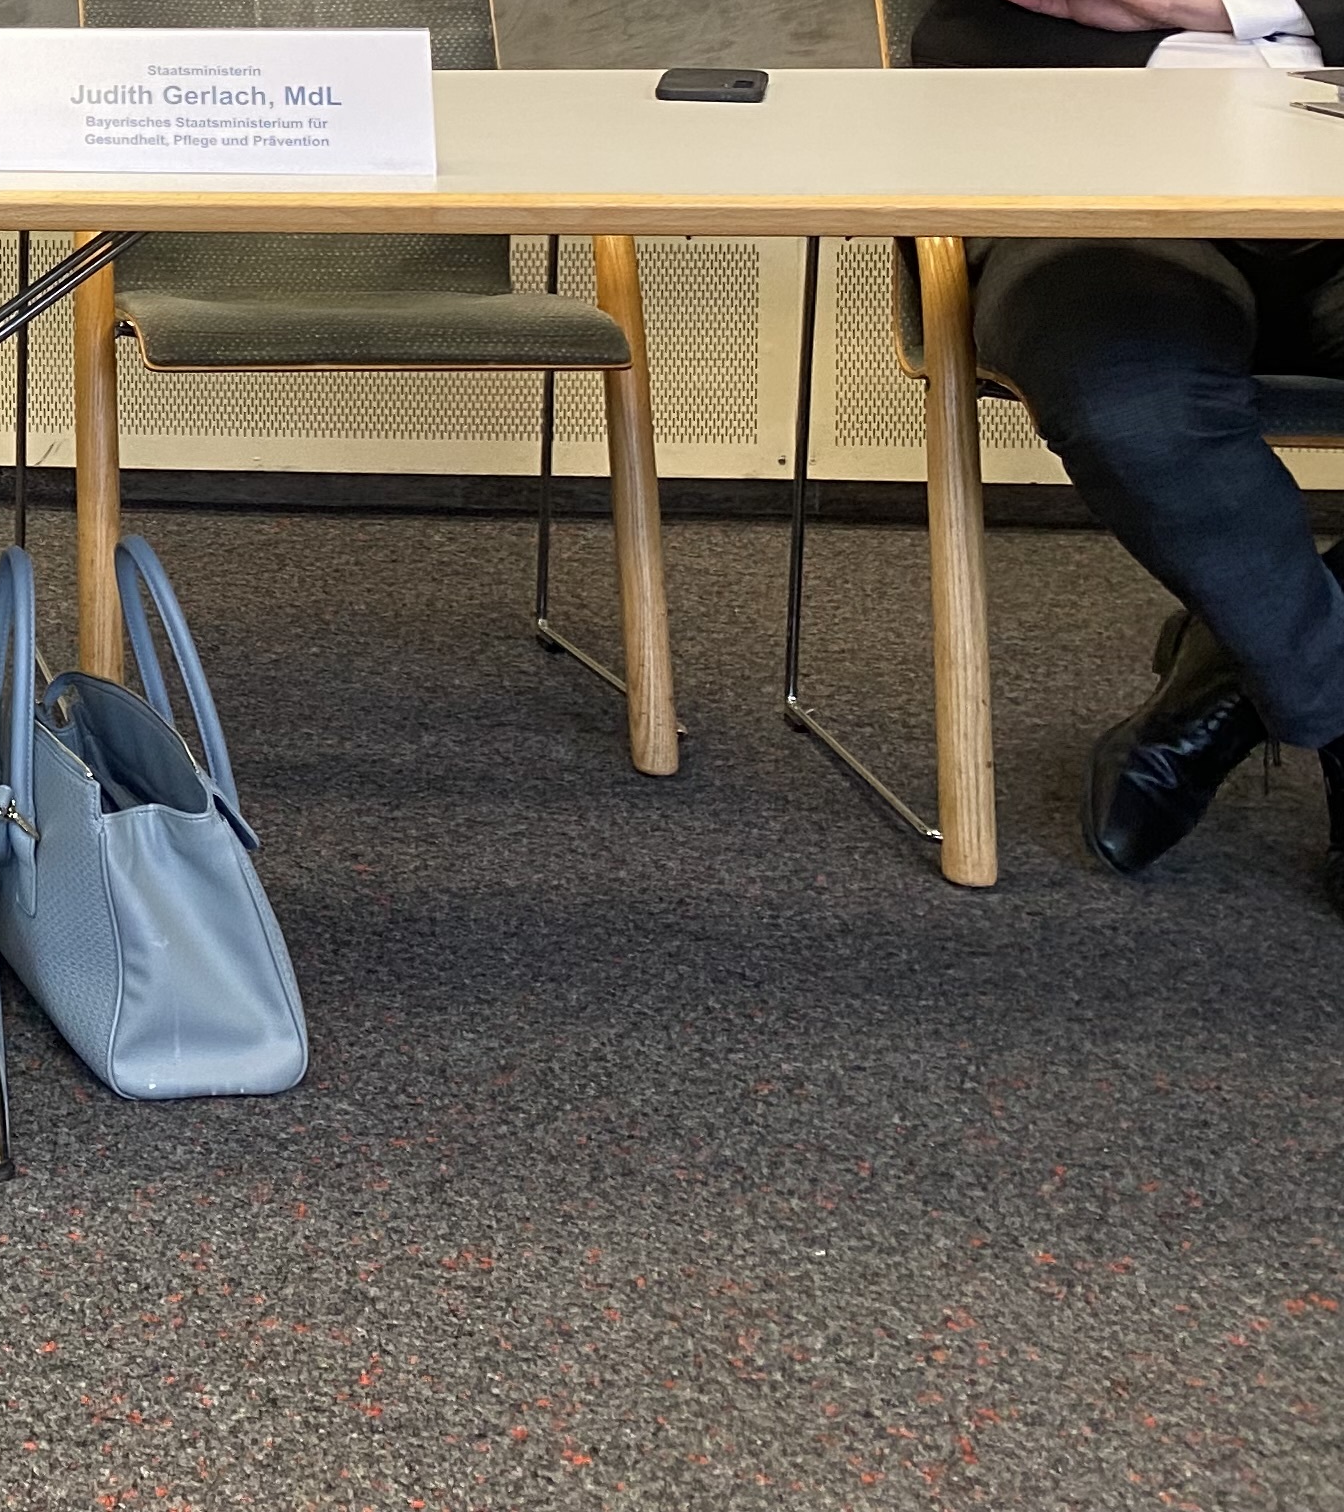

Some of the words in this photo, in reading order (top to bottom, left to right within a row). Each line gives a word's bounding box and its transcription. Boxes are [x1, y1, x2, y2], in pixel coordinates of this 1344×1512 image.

[147, 65, 261, 76] Staatsministerin
[70, 84, 153, 104] Judith
[163, 85, 274, 108] Gerlach,
[284, 85, 342, 106] MdL
[85, 115, 171, 129] Bayerisches
[175, 116, 303, 129] Staatsministerium
[308, 117, 328, 128] für
[84, 133, 170, 147] Gesundheit,
[173, 134, 217, 148] Pflege
[221, 135, 248, 146] und
[253, 135, 330, 147] Prävention
